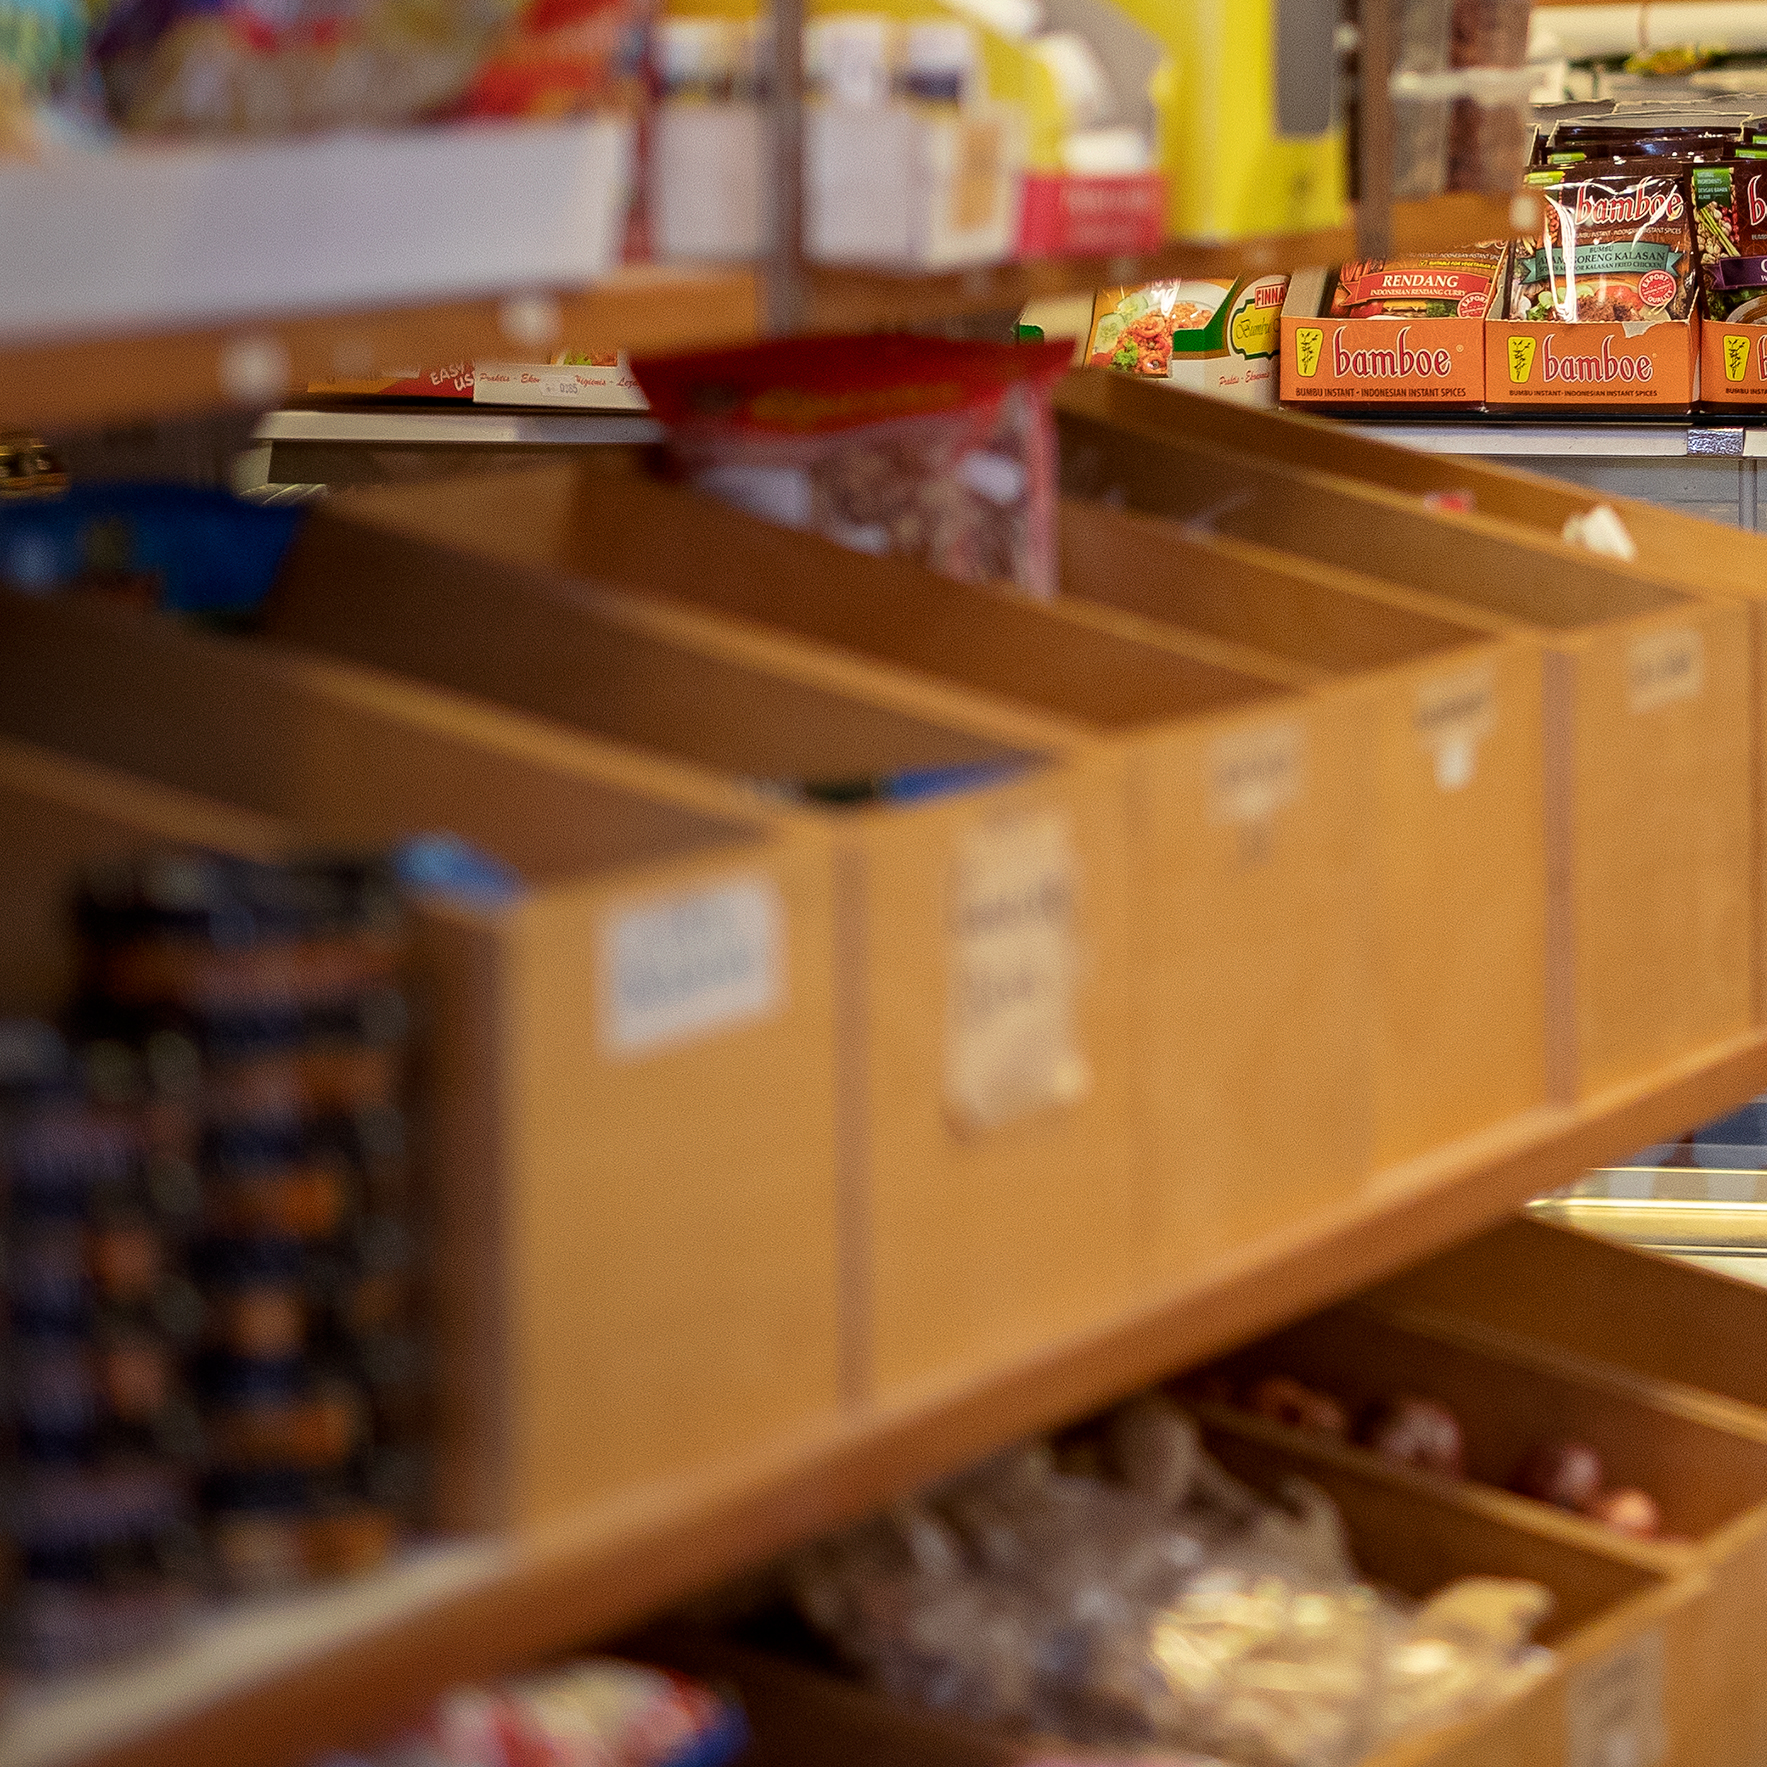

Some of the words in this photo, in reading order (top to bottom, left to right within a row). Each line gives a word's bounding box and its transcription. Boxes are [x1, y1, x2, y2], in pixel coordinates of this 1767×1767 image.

[1575, 175, 1683, 225] bamboe
[1614, 250, 1666, 262] KALASAN
[1256, 286, 1285, 306] FINNA
[1382, 275, 1459, 288] RENDANG
[1333, 325, 1451, 378] bamboe
[1542, 334, 1653, 383] bamboe
